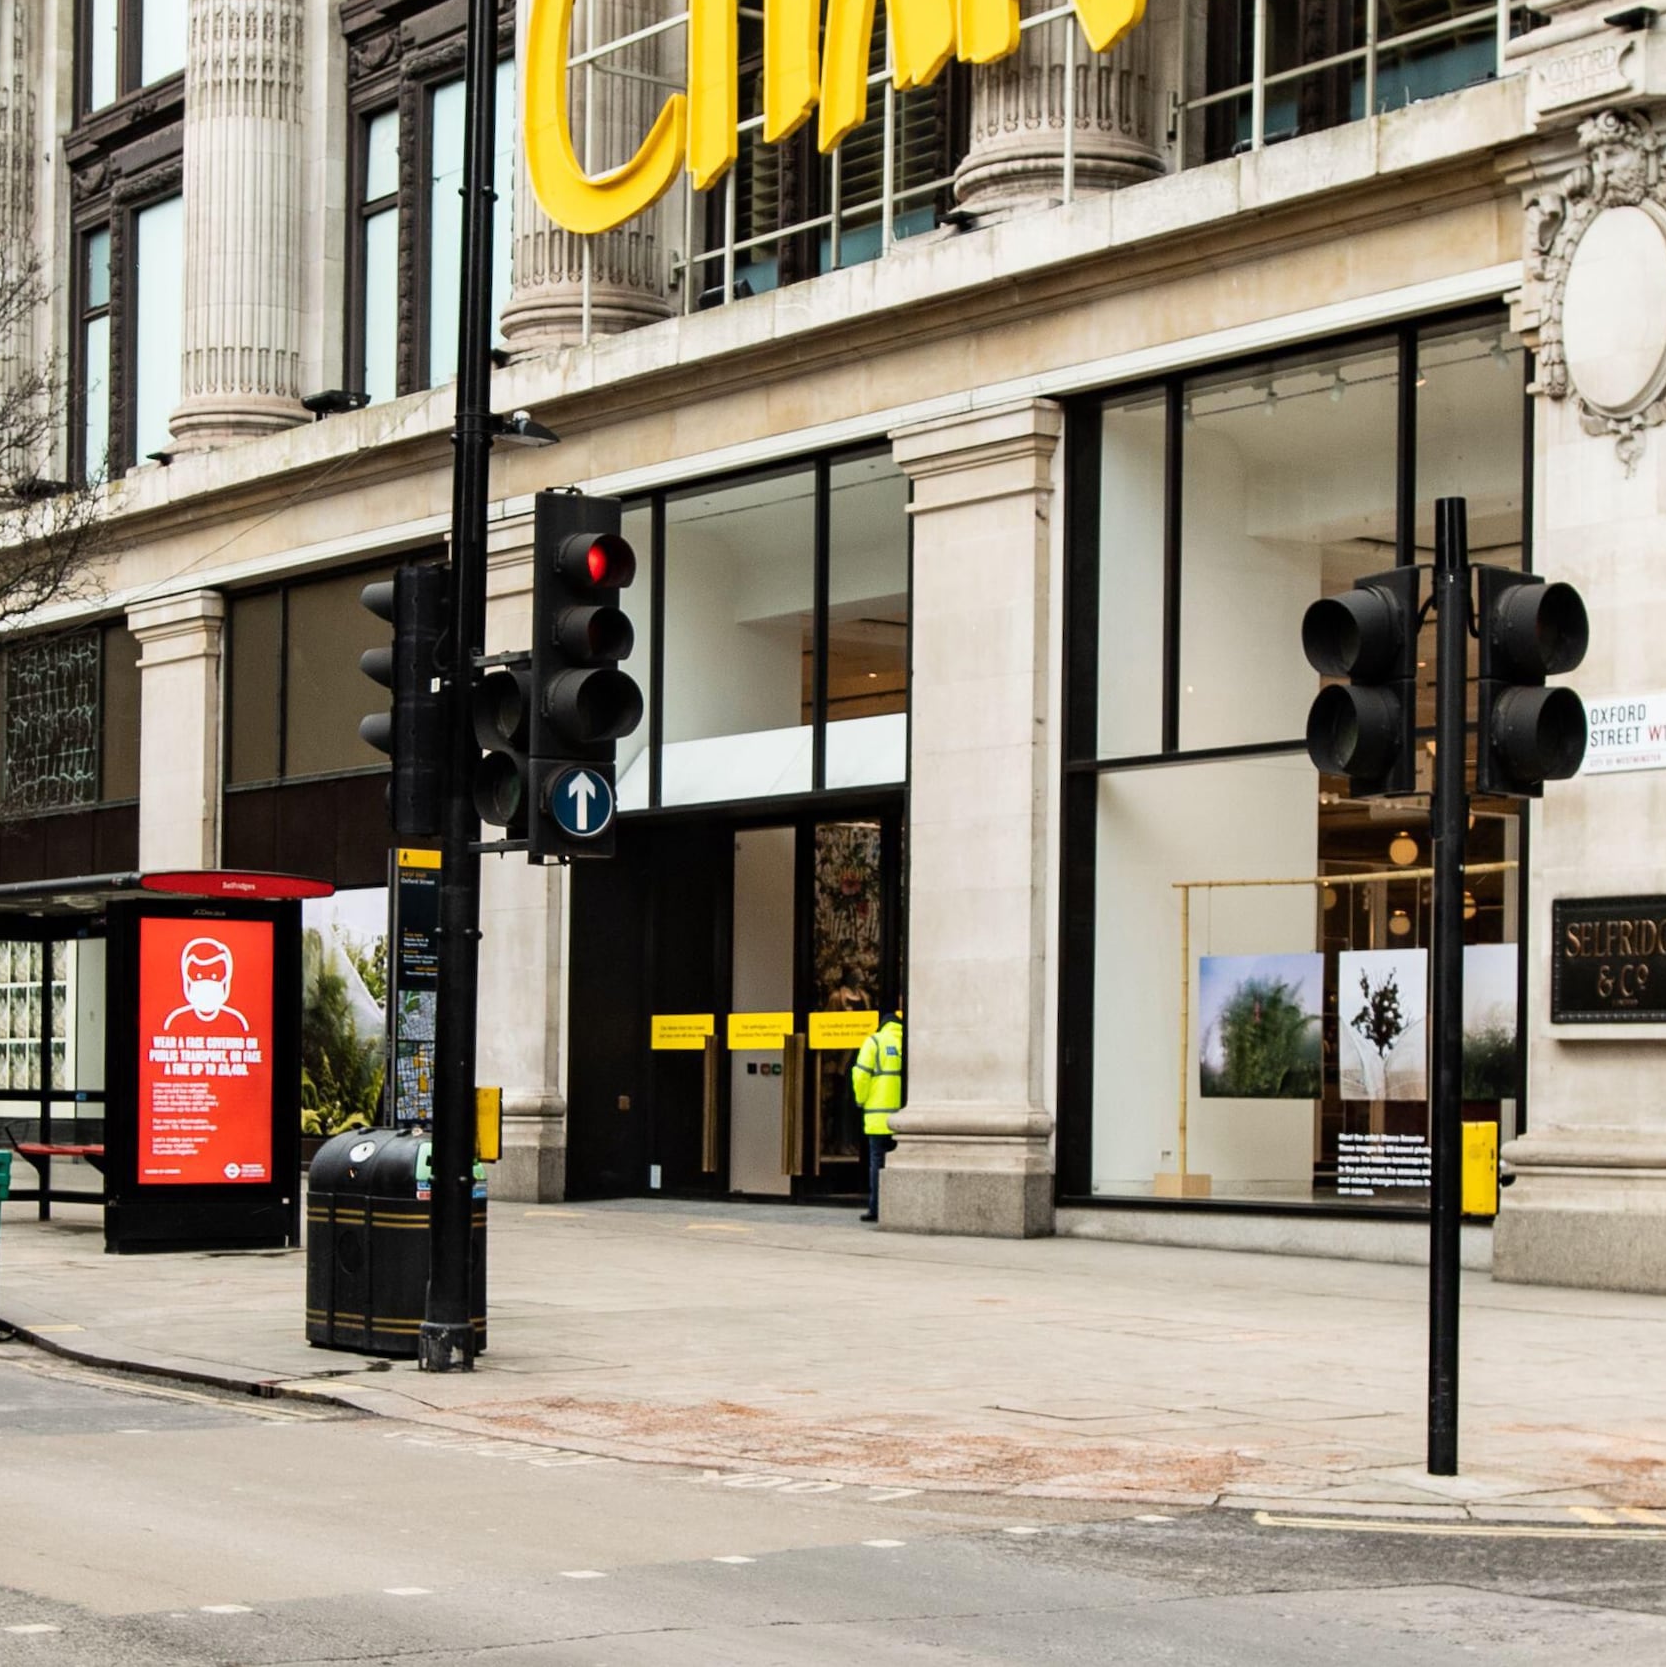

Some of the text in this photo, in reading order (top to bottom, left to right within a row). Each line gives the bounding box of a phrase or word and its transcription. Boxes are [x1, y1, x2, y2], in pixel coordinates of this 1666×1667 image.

[1590, 704, 1646, 726] OXFORD
[1590, 725, 1666, 748] STREET W1
[222, 881, 255, 892] Selfridges
[1598, 965, 1615, 997] &
